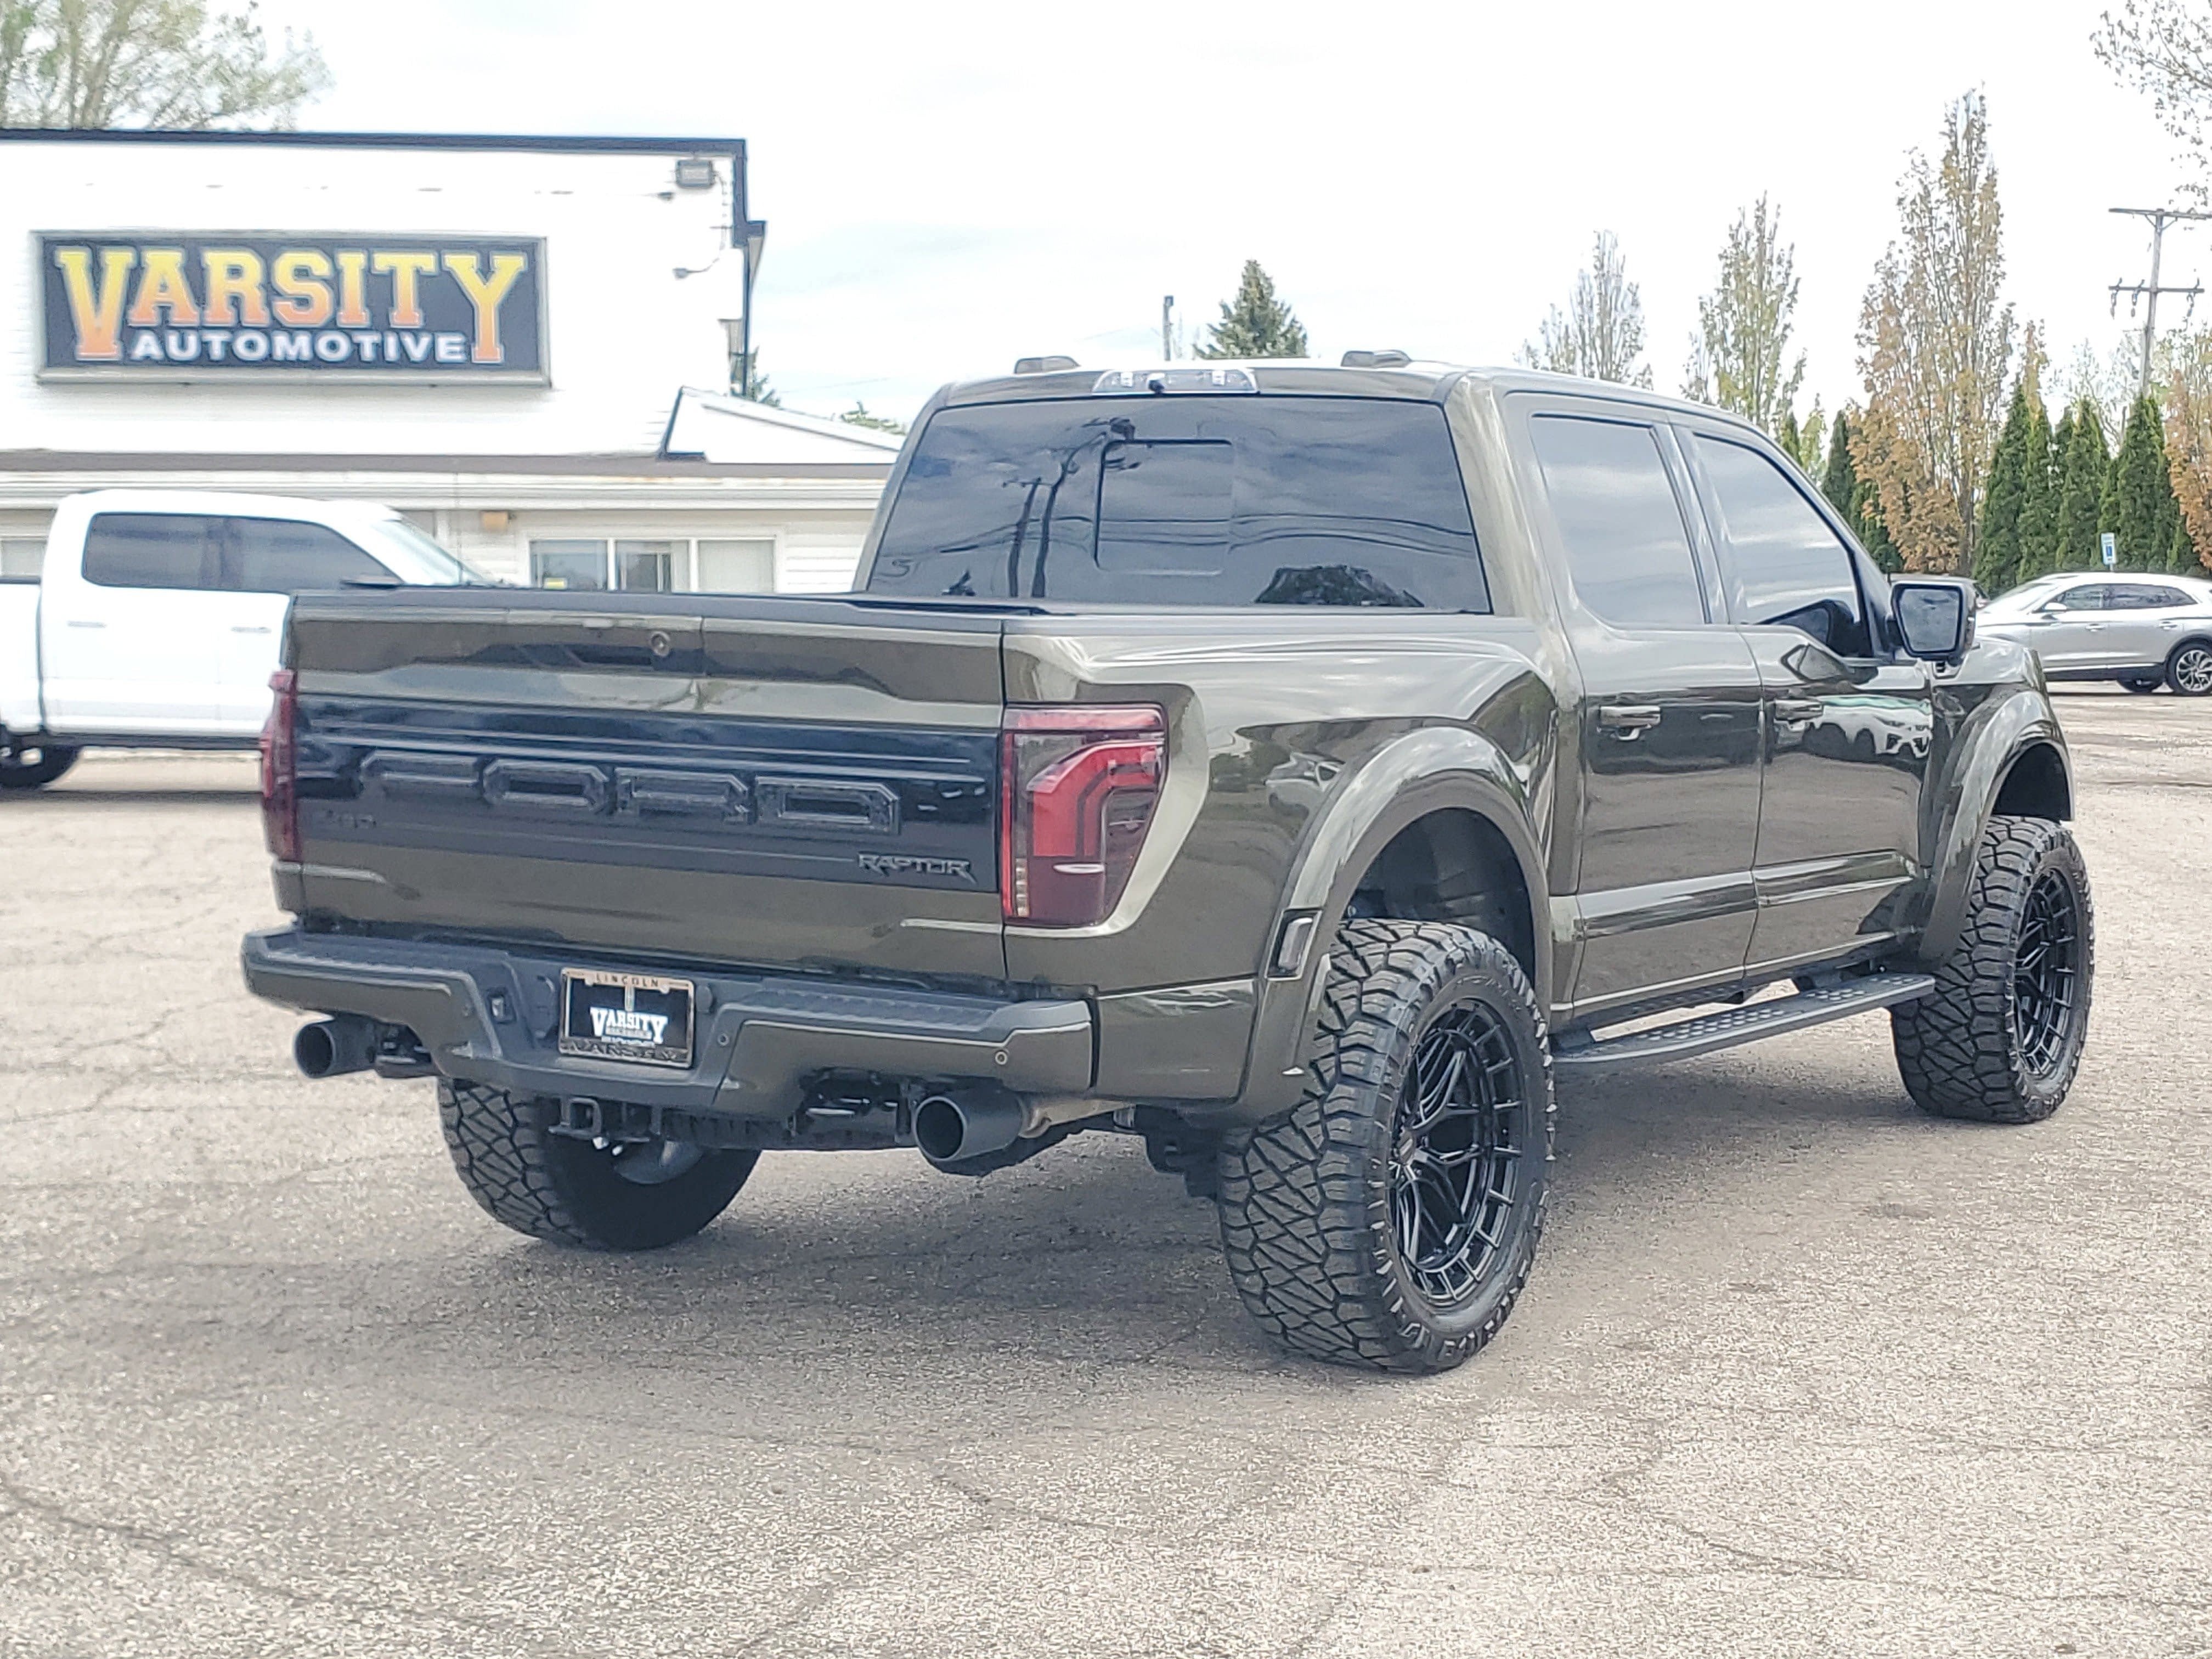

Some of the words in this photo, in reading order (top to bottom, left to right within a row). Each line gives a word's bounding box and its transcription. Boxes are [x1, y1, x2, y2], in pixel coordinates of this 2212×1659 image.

[57, 249, 526, 363] VARSITY
[131, 332, 467, 362] AUTOMOTIVE
[360, 749, 900, 834] FORD
[858, 853, 977, 883] RAPTOR
[596, 973, 659, 987] LINCOLN
[590, 1006, 668, 1044] VARSITY
